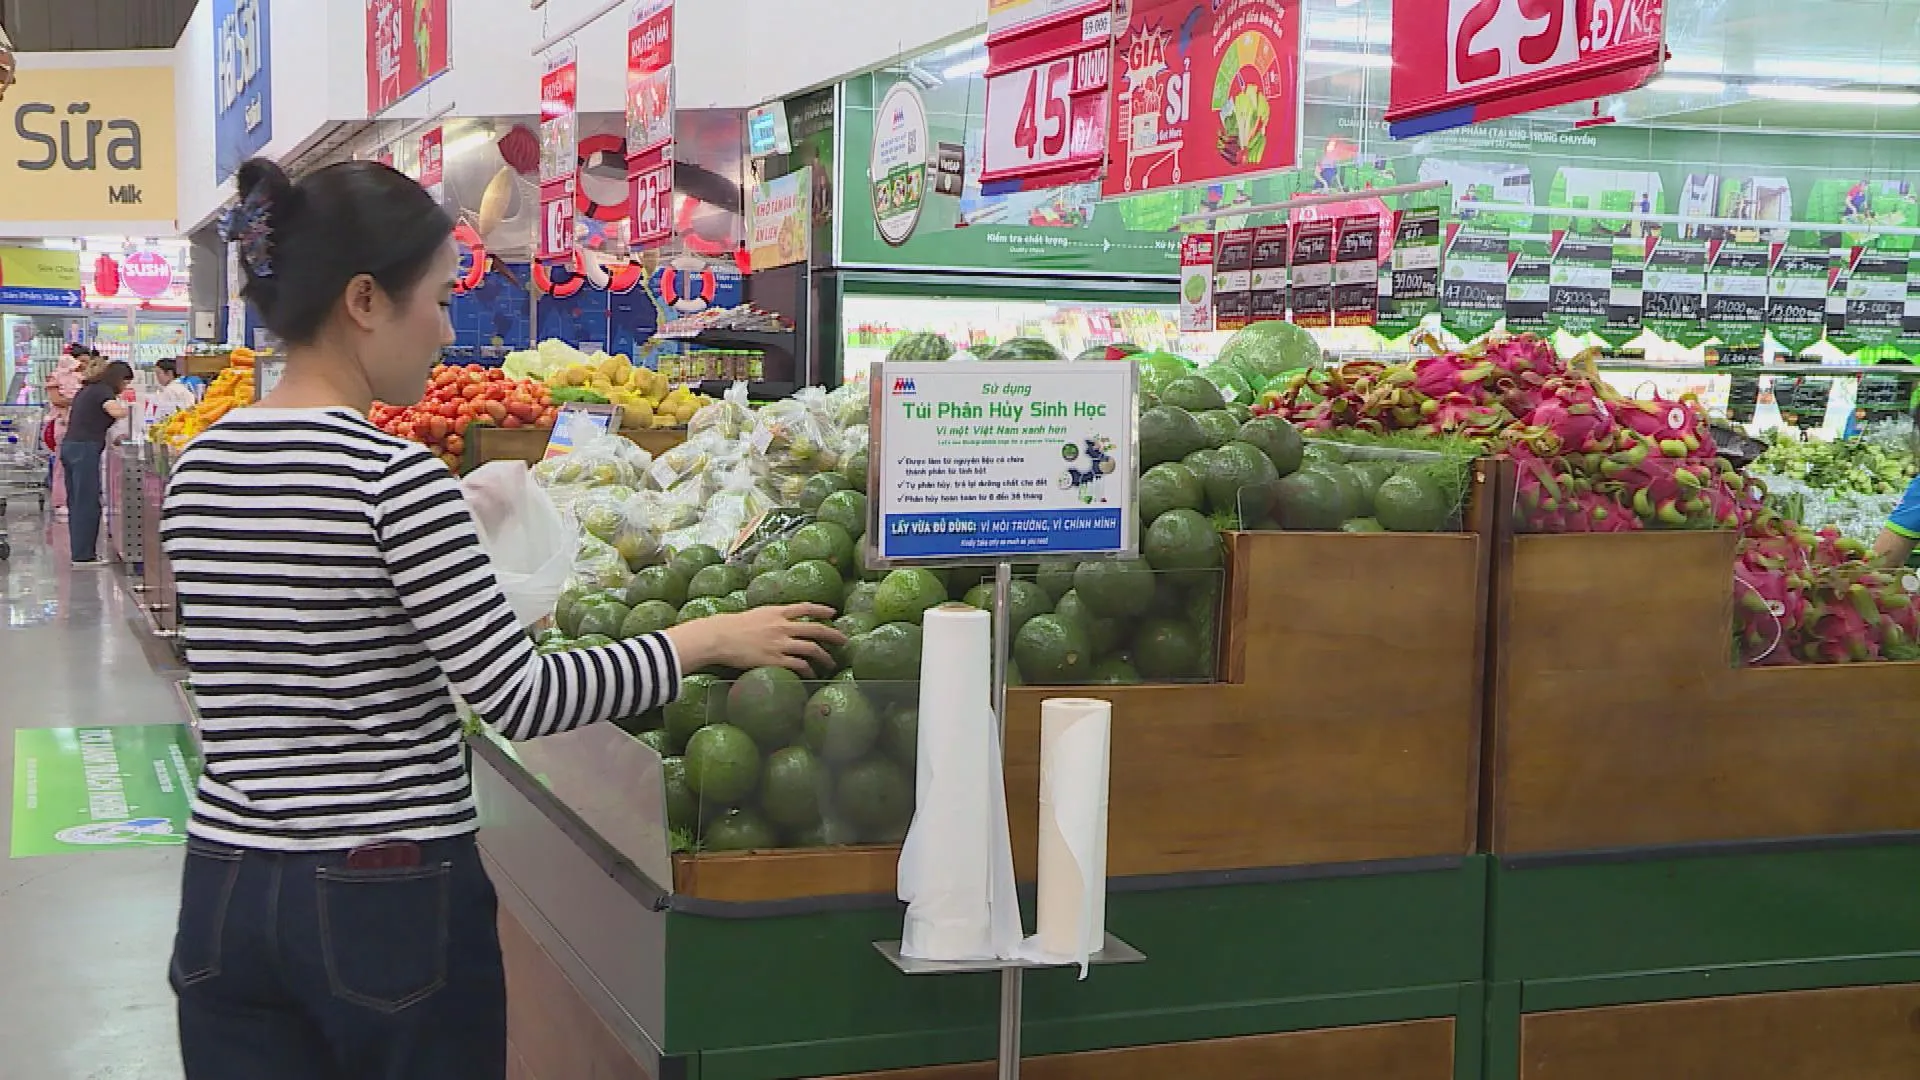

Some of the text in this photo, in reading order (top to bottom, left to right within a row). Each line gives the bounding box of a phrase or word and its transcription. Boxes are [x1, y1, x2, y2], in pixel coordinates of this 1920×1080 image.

[1014, 51, 1106, 159] 45 000
[14, 102, 141, 170] Sữa
[108, 183, 142, 204] Milk
[126, 263, 170, 277] SUSHI
[982, 382, 1032, 397] Sử dụng
[902, 400, 1107, 422] Túi Phân Hủy Sinh Học
[950, 426, 969, 437] một
[973, 426, 993, 437] Việt
[997, 426, 1019, 435] Nam
[1022, 425, 1046, 435] xanh
[892, 516, 1117, 535] LẤY VỪA ĐỦ DÙNG: VÌ MÔI TRƯỜNG, VÌ CHÍNH MÌNH
